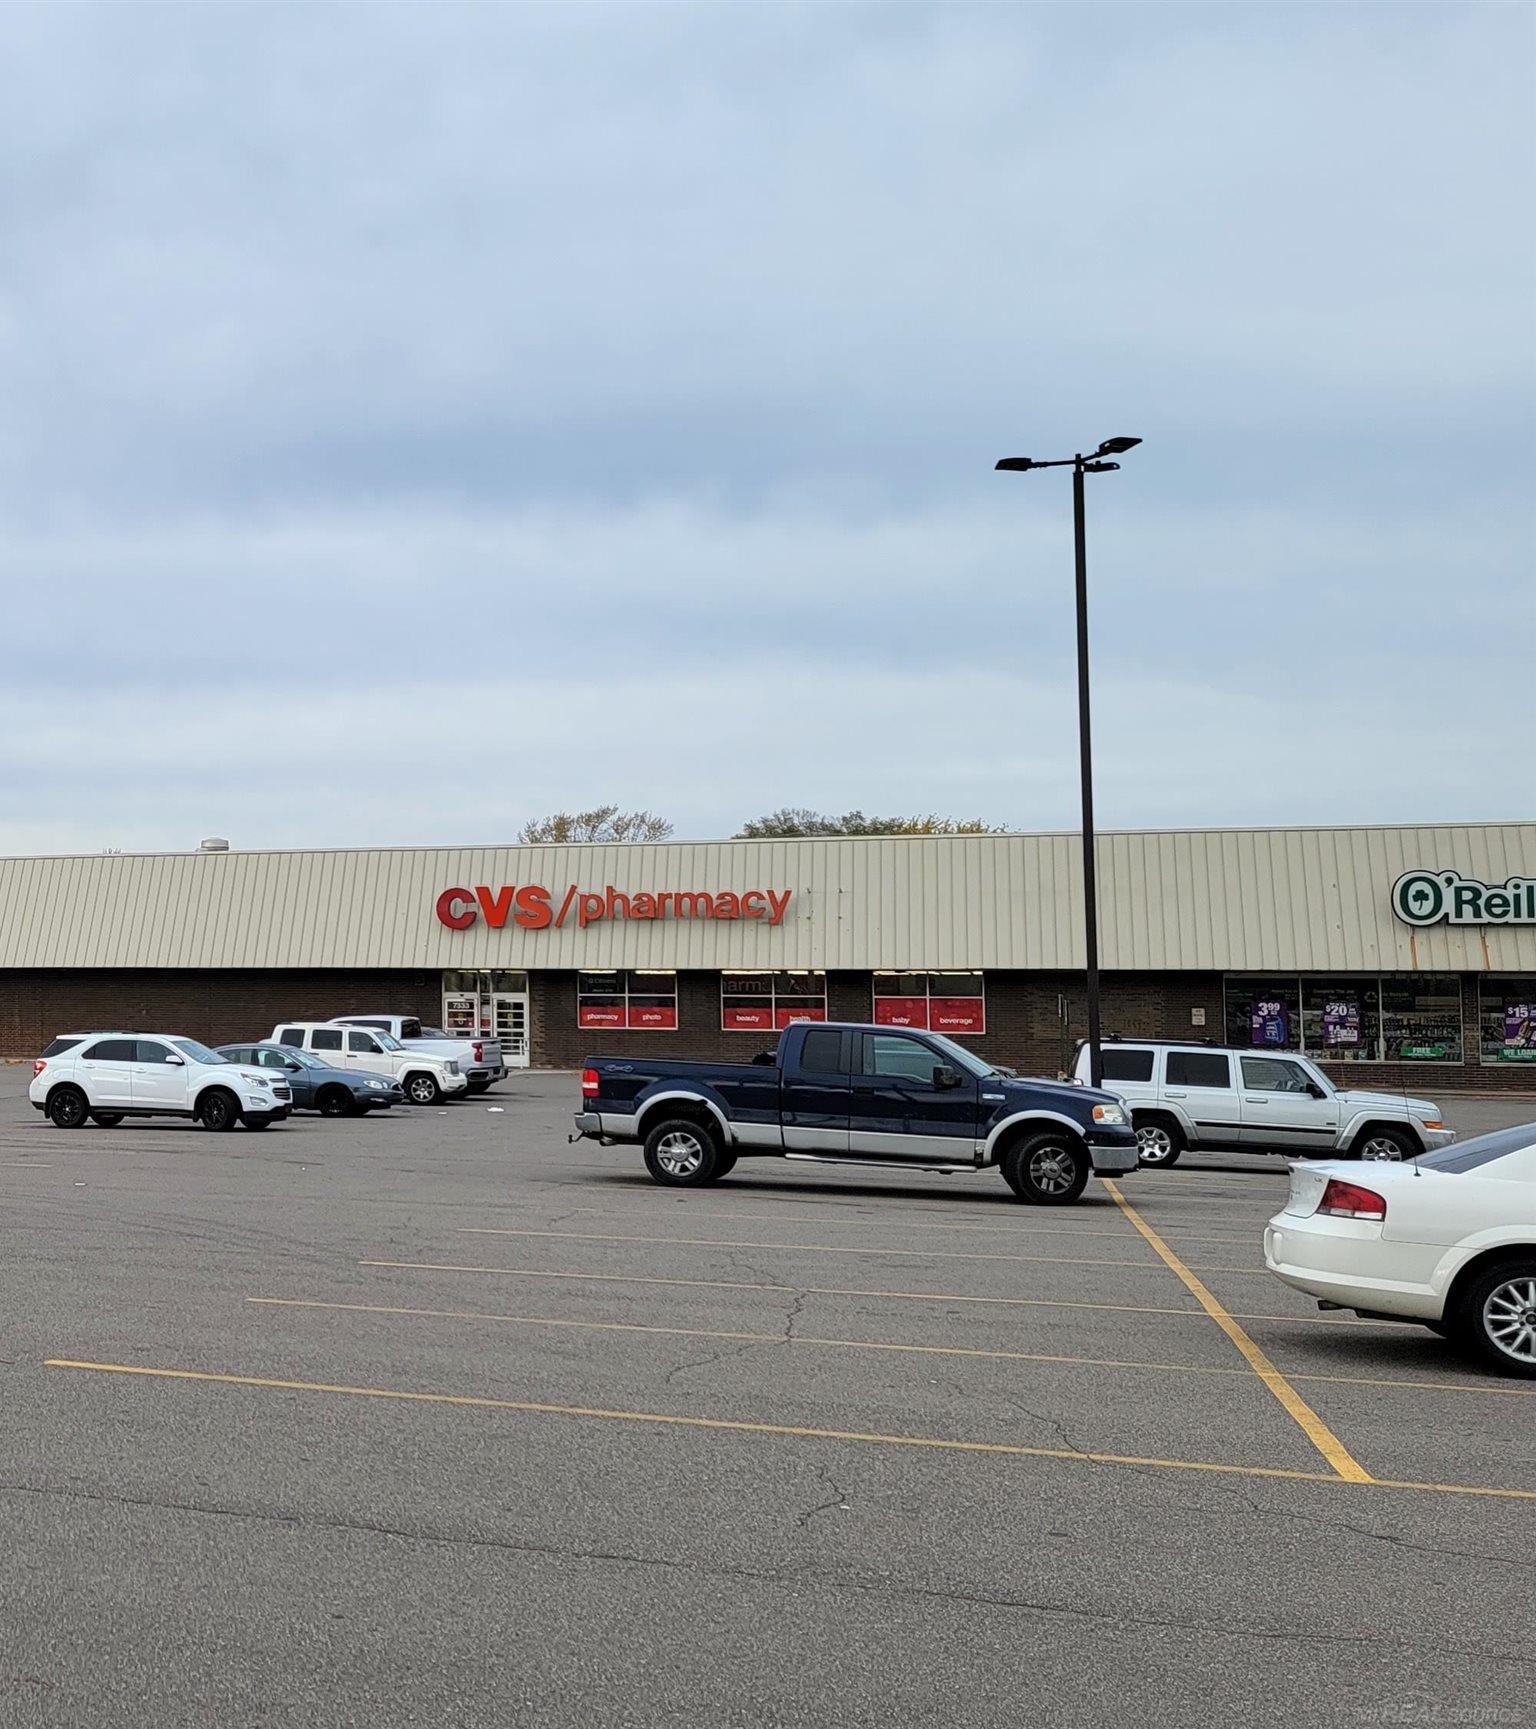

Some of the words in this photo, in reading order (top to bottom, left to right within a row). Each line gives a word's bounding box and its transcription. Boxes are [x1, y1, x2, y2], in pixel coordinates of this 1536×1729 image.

[436, 884, 792, 930] CVS/pharmacy
[1326, 1005, 1348, 1016] $20
[1507, 1007, 1529, 1018] $15
[586, 1013, 619, 1021] pharmacy
[891, 1016, 911, 1024] baby
[939, 1017, 974, 1025] beverage
